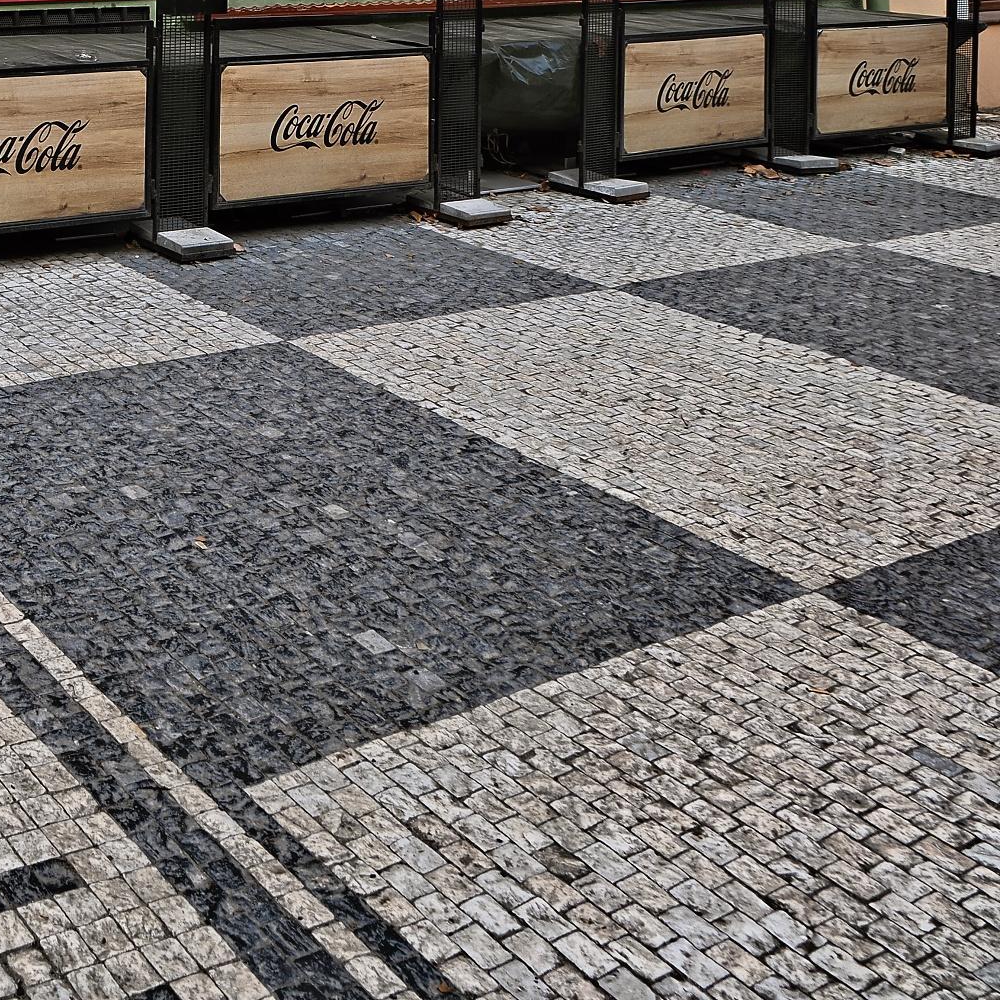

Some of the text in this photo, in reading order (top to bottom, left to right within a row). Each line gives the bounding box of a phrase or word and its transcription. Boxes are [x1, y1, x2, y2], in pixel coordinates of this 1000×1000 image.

[657, 68, 734, 112] Coca-Cola
[849, 56, 920, 97] Coca-Cola
[270, 99, 385, 152] Coca-Cola
